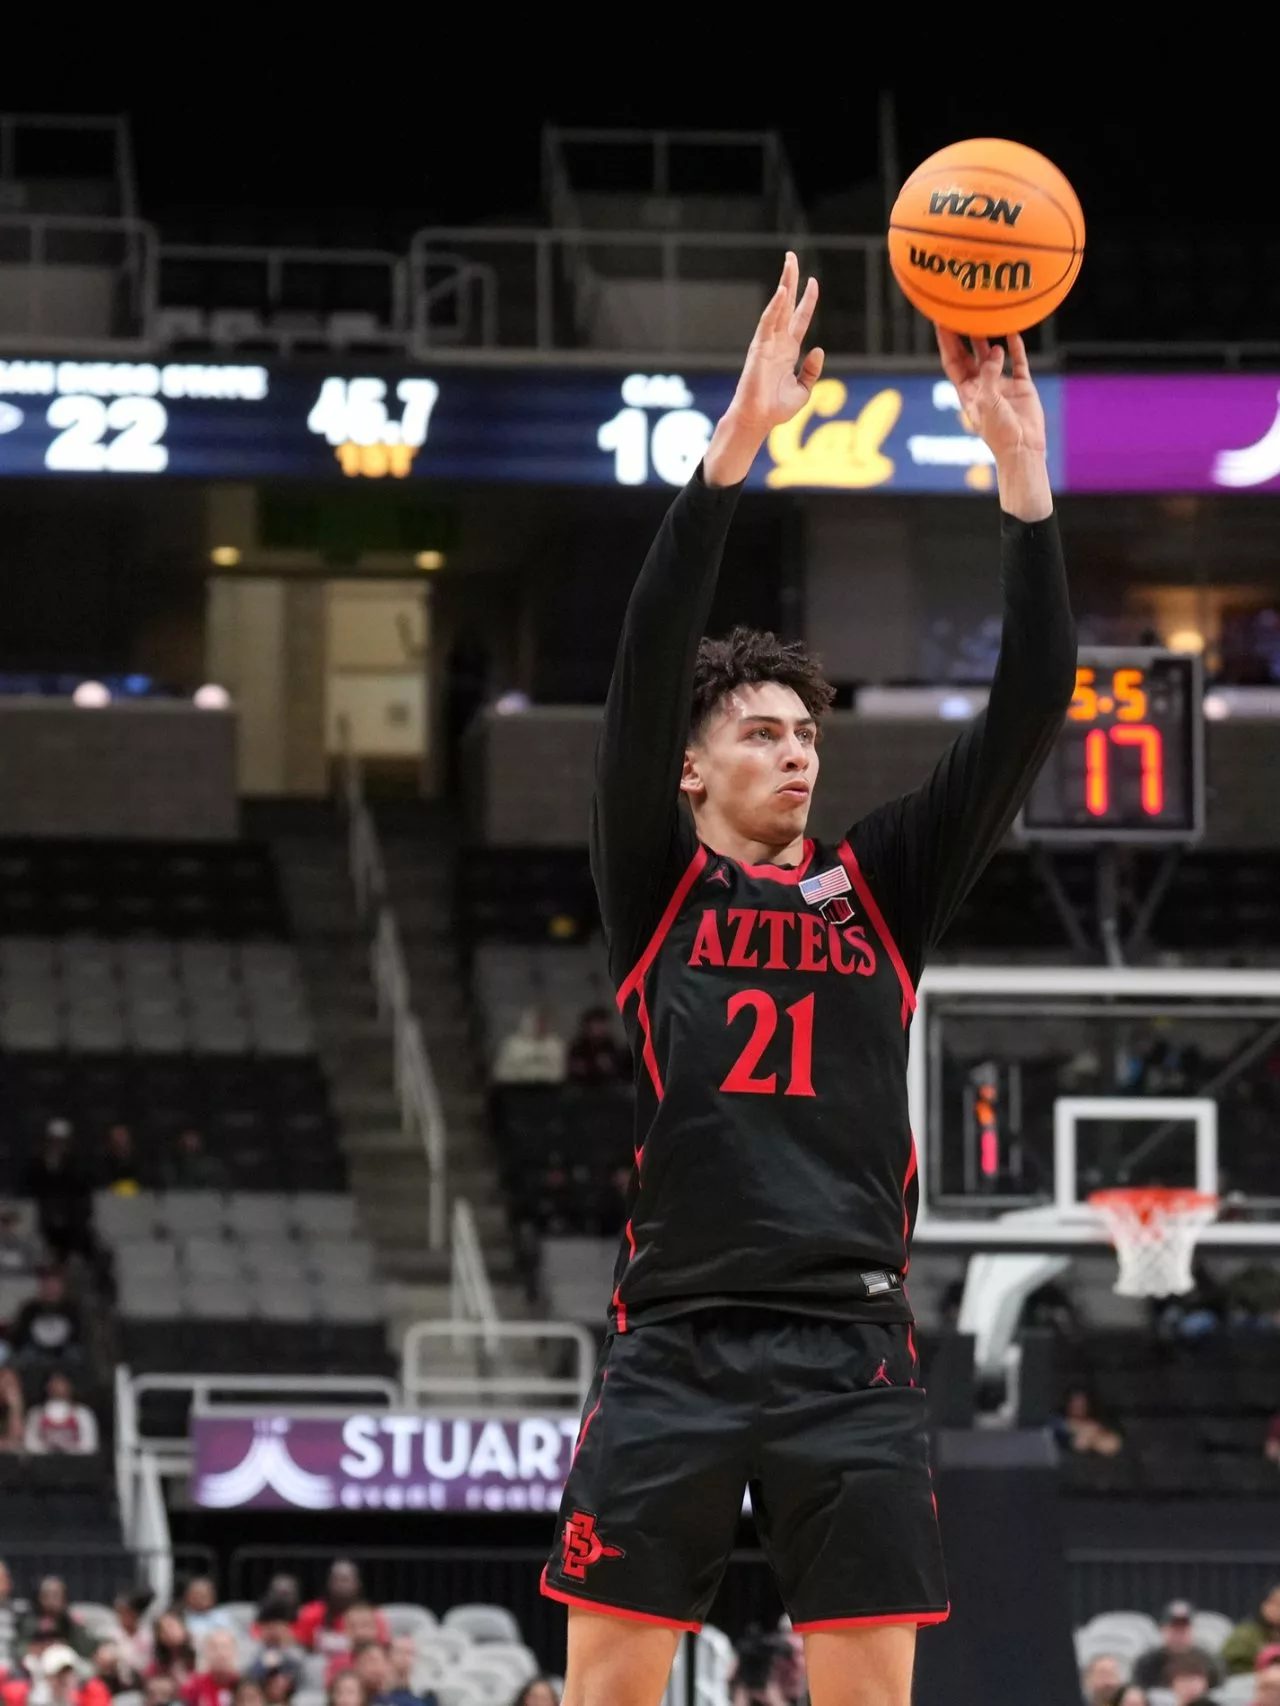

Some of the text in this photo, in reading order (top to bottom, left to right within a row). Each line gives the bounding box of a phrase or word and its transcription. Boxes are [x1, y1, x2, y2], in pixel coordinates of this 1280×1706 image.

[928, 190, 1023, 228] NCAA
[909, 246, 1033, 292] Wilson
[44, 394, 168, 472] 22
[597, 407, 714, 487] 16
[766, 379, 902, 488] Cal
[1085, 723, 1163, 816] 17
[719, 989, 816, 1097] 21
